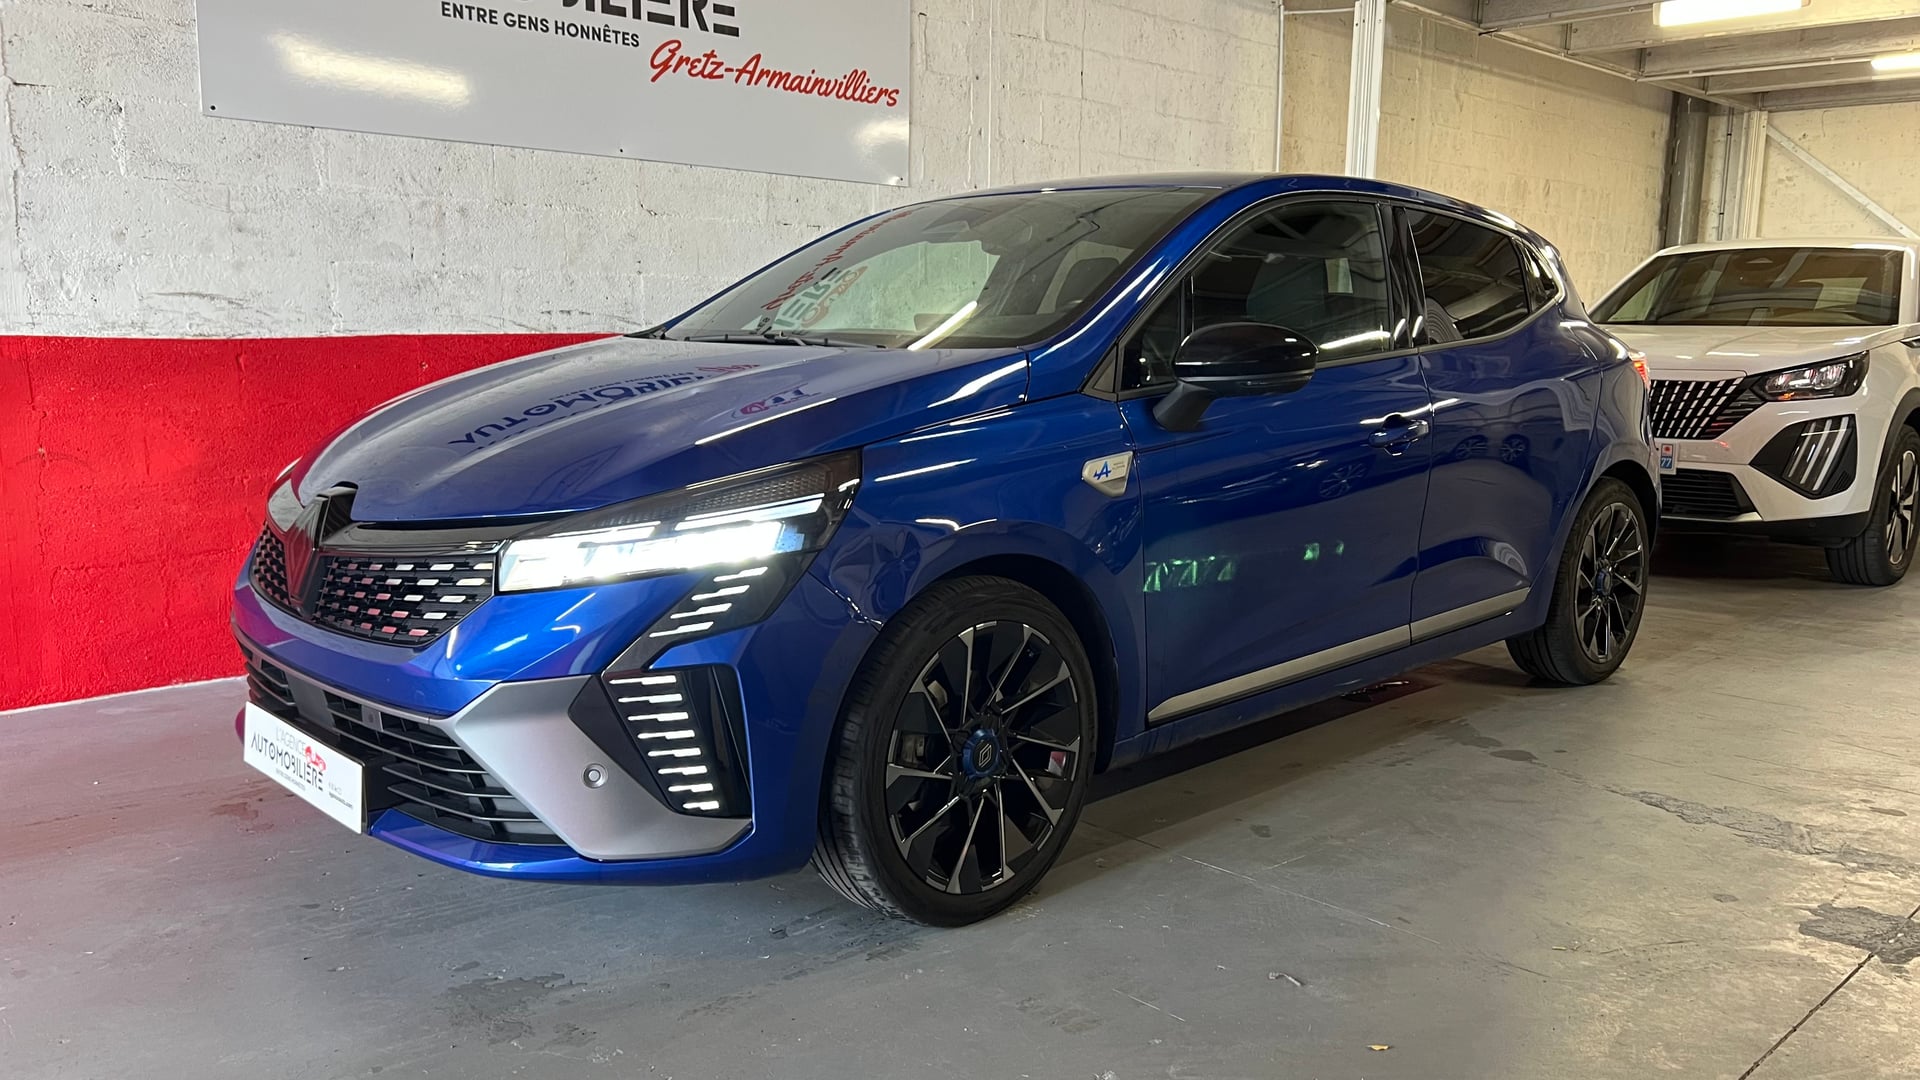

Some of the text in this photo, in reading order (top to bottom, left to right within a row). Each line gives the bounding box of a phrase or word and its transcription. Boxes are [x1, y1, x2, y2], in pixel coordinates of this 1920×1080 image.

[441, 1, 640, 47] ENTRE GENS HONNÊTES
[650, 39, 899, 107] Gretz-Armainvilliers
[1661, 457, 1672, 467] 77
